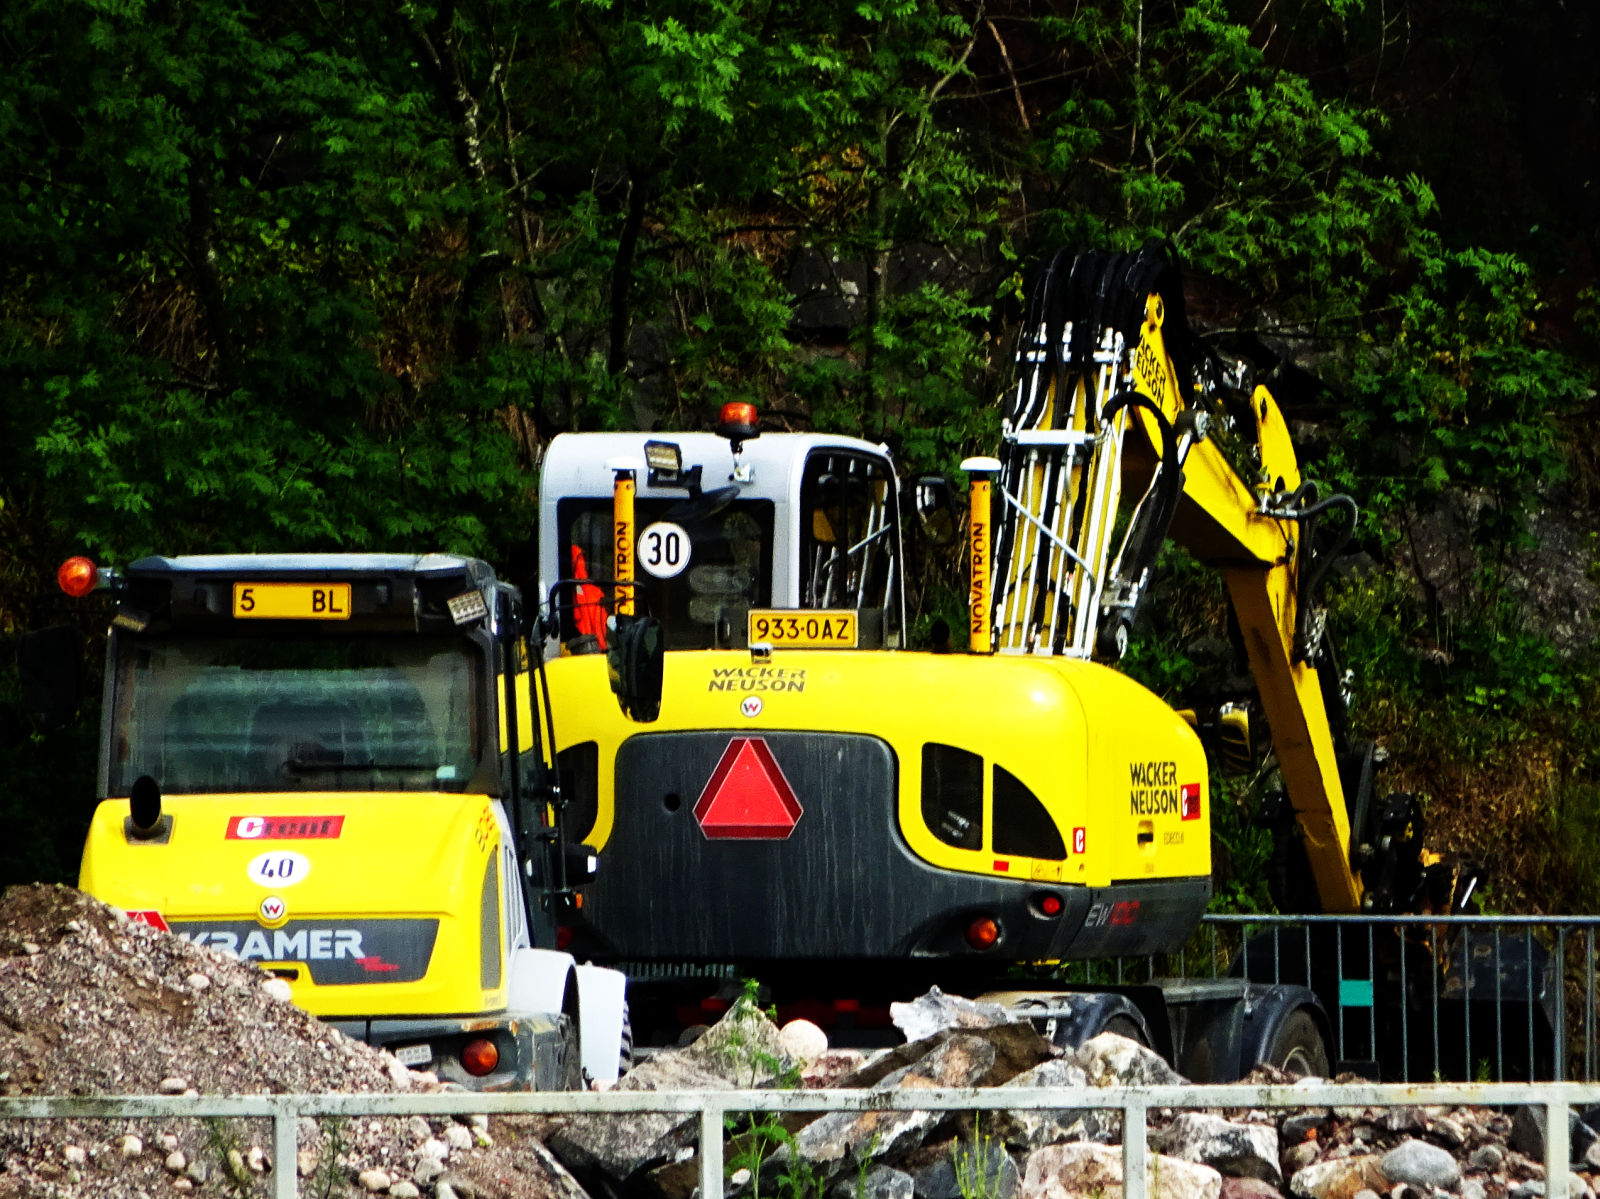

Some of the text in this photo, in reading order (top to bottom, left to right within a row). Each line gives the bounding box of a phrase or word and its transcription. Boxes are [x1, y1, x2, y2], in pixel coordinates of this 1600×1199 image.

[1137, 350, 1164, 409] EUSON
[648, 532, 680, 566] 30
[972, 522, 985, 633] NOVATRON
[240, 588, 343, 613] 5 BL
[713, 667, 806, 679] WACKER
[708, 679, 806, 693] NEUSON
[1130, 762, 1177, 787] WACKER
[1130, 789, 1178, 816] NEUSON
[261, 858, 294, 878] 40
